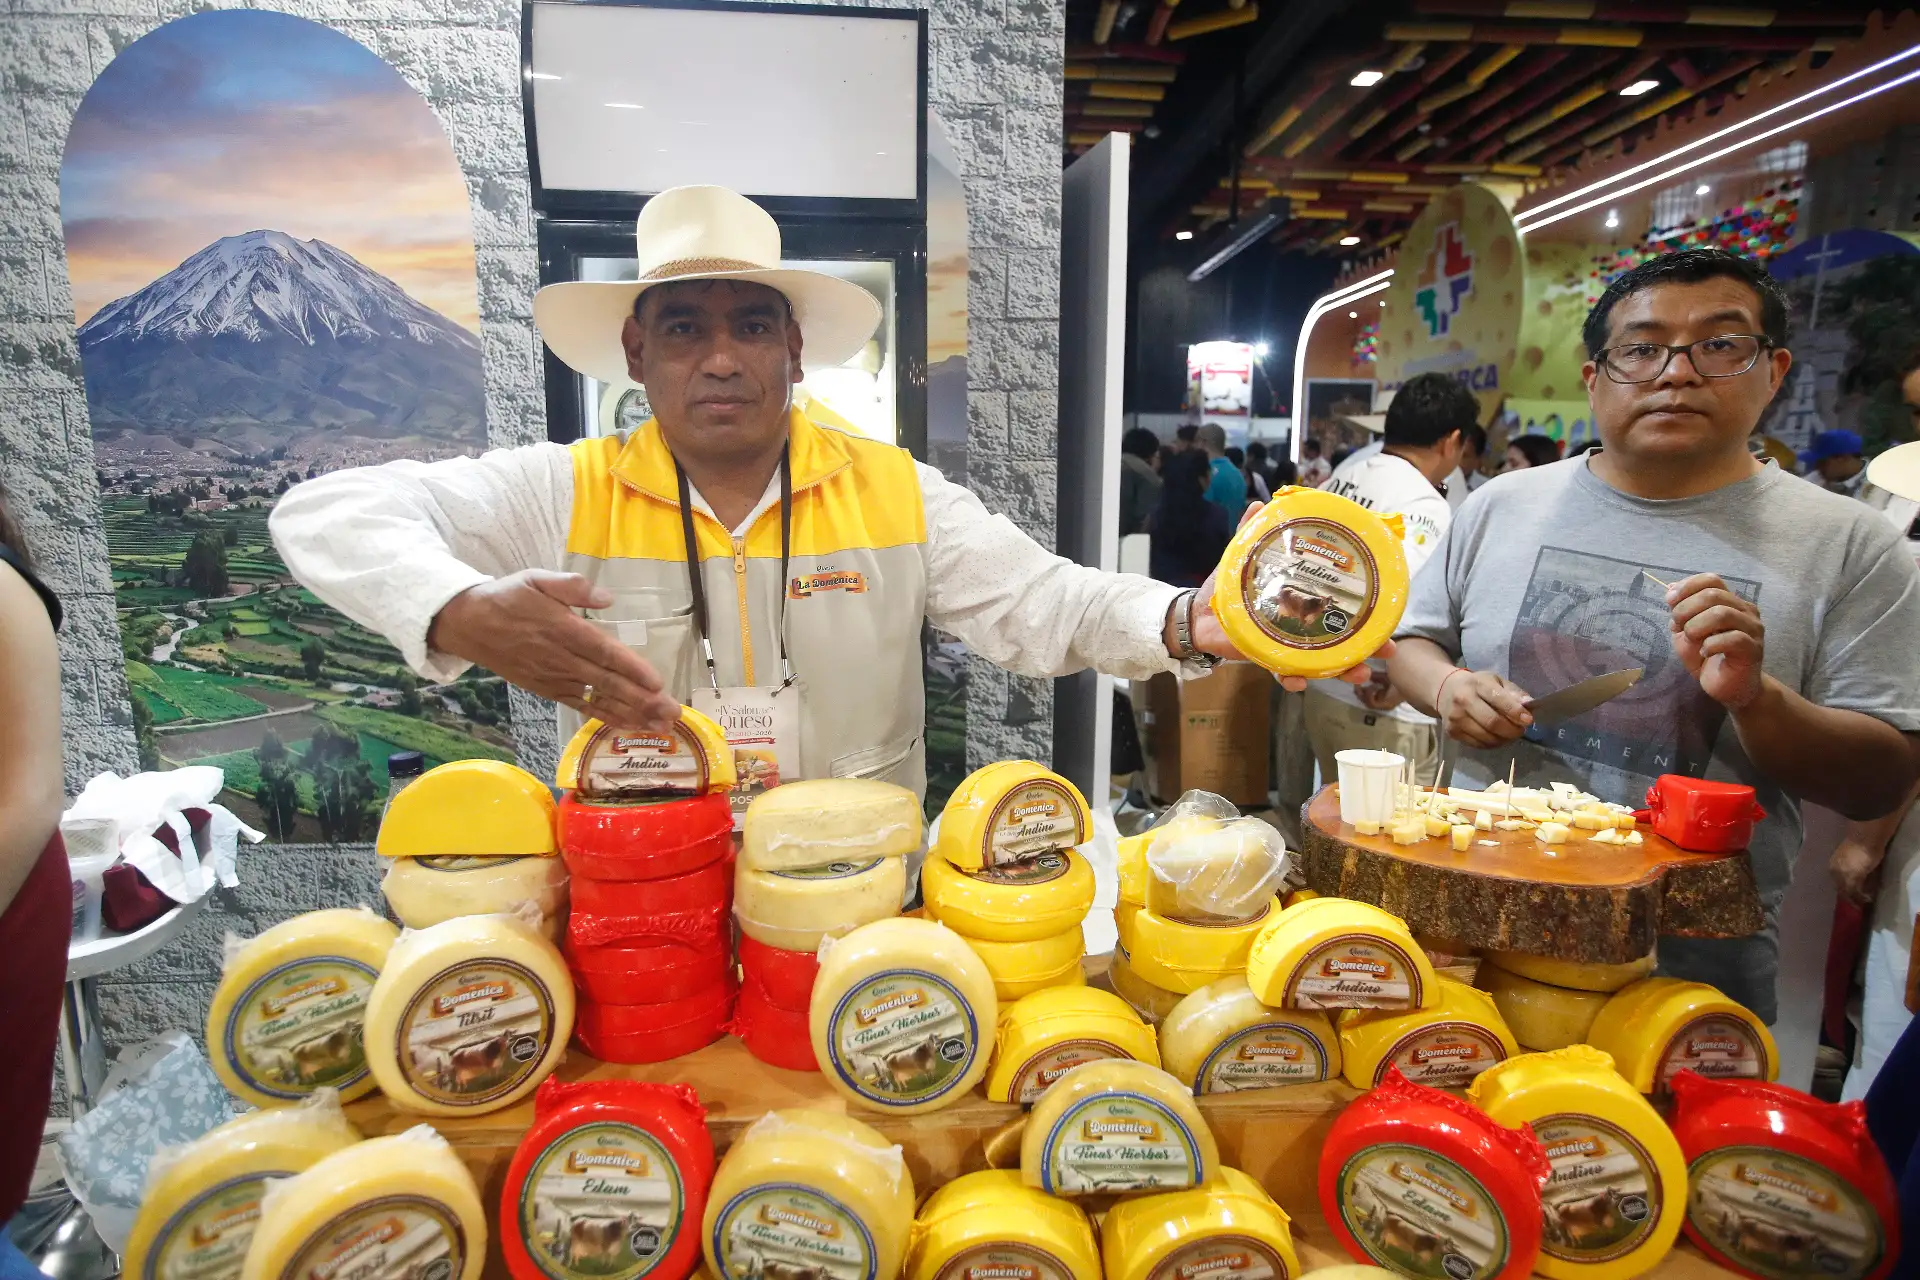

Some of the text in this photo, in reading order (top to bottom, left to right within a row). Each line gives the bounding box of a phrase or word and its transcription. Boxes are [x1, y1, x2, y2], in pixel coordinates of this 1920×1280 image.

[1316, 530, 1338, 544] Queso
[1295, 538, 1349, 564] Domenica
[1289, 560, 1342, 583] Andino
[796, 576, 859, 590] La Domenica
[617, 737, 671, 748] Domenica
[1530, 722, 1698, 773] LEMENT
[619, 756, 671, 769] Andino
[1013, 803, 1055, 818] Domenica
[1016, 821, 1056, 838] Andino
[1329, 959, 1387, 973] Domenica
[872, 984, 896, 997] Queso
[1328, 980, 1384, 994] Andino
[440, 984, 505, 1009] Domenica
[861, 992, 920, 1020] Domenica
[456, 1007, 497, 1028] Tilsit
[1245, 1045, 1297, 1057] Domenica
[1417, 1046, 1473, 1059] Domenica
[1691, 1040, 1738, 1051] Domenica
[1417, 1064, 1471, 1077] Andino
[1090, 1120, 1153, 1135] Domenica
[1073, 1144, 1171, 1162] Finas Hierbas
[1546, 1140, 1595, 1157] menica
[575, 1152, 642, 1169] Domenica
[1549, 1163, 1605, 1183] Andino
[582, 1178, 631, 1196] Edam
[1400, 1164, 1469, 1207] Domenica
[1402, 1189, 1452, 1222] Edam
[767, 1207, 833, 1233] Domenica
[970, 1266, 1032, 1278] Domenica
[1181, 1255, 1243, 1277] Domenica
